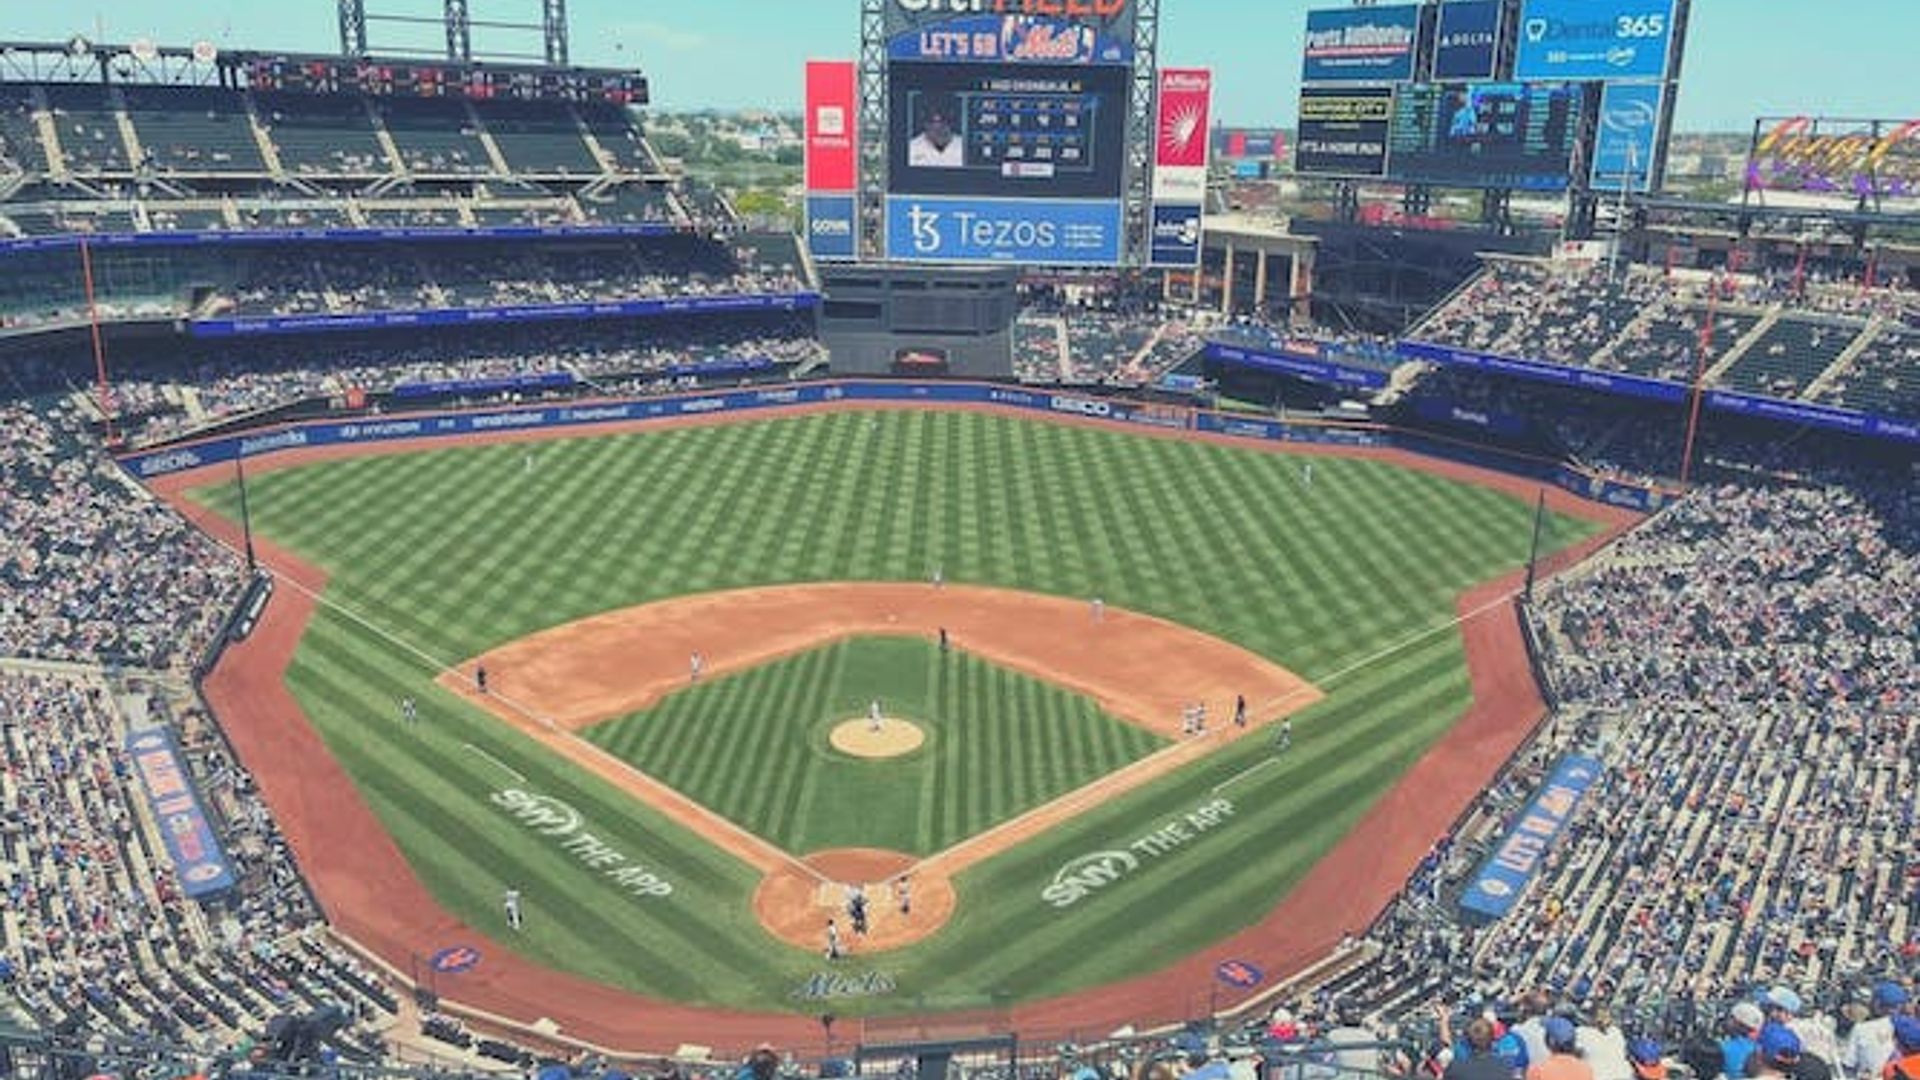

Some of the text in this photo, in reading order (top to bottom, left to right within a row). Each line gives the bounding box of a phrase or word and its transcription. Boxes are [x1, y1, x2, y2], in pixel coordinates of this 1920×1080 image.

[920, 32, 968, 56] LET'S
[1452, 32, 1493, 46] DELTA
[952, 211, 1056, 247] Tezos
[1051, 396, 1110, 416] GEICO
[490, 789, 673, 896] SNY THE APP
[1041, 797, 1236, 907] SNY THE APP
